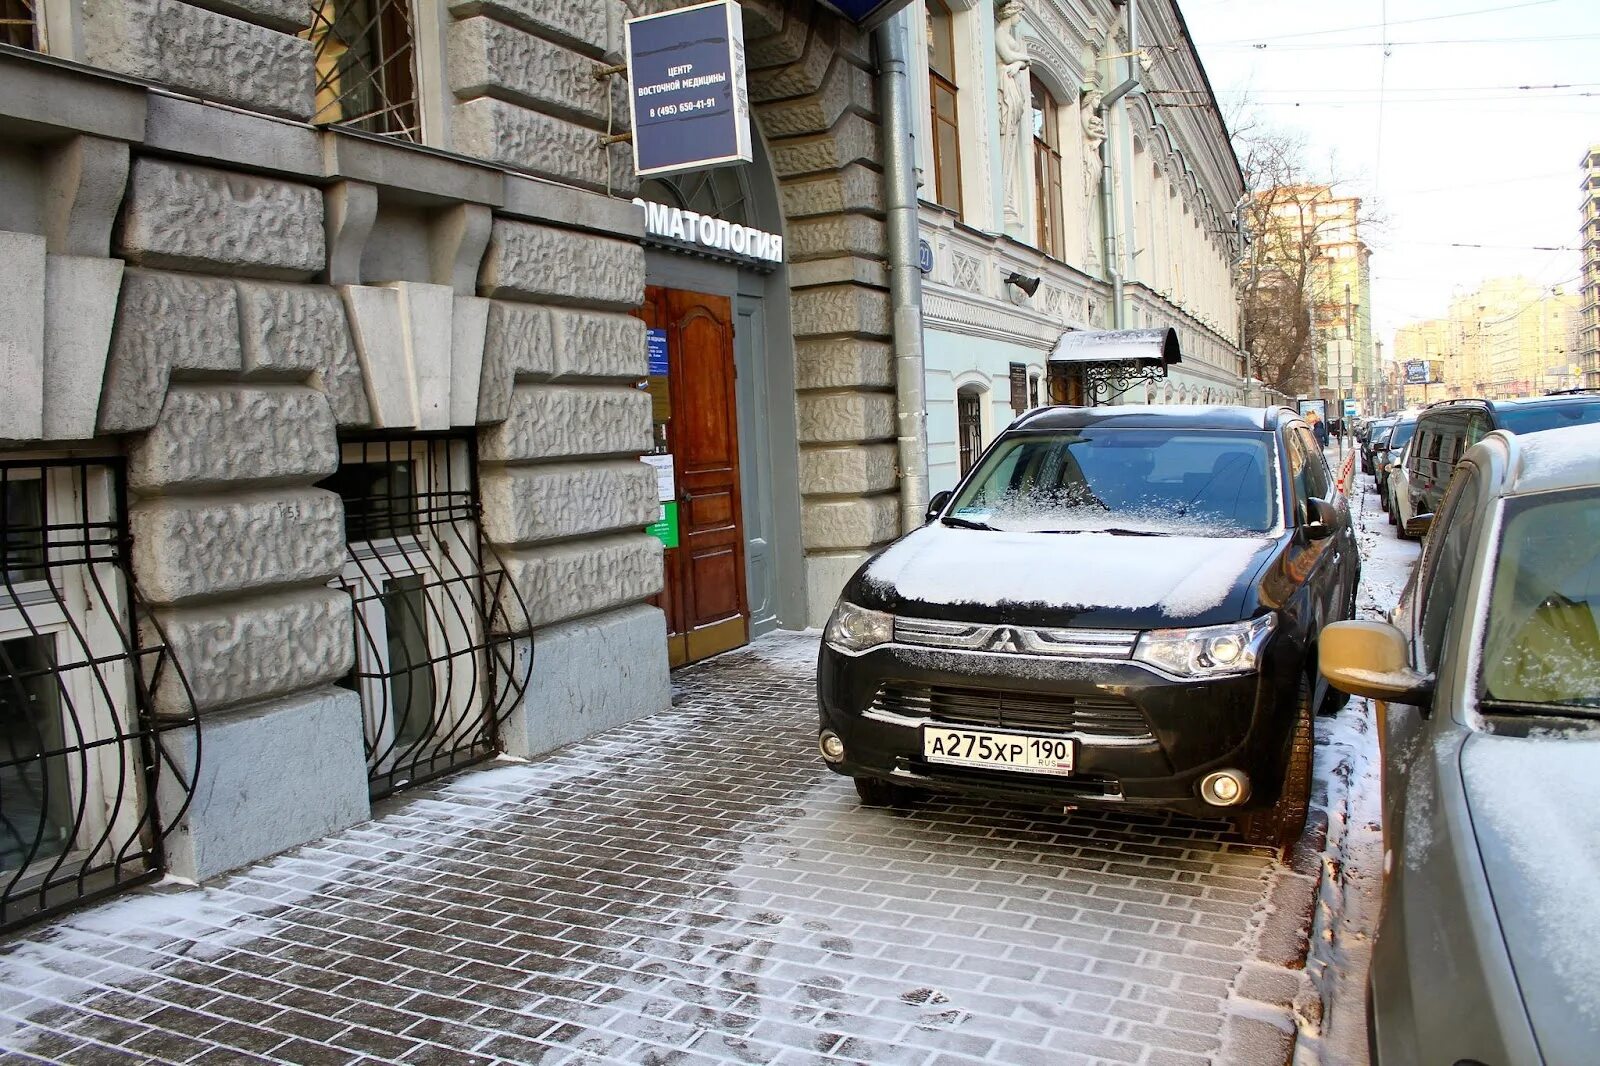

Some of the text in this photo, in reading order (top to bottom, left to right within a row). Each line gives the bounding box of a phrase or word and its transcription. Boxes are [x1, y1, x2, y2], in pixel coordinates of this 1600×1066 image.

[668, 64, 692, 77] ЦЕНТР
[638, 72, 726, 96] ВОСТОЧНОЙ МЕДИЦИНЫ
[649, 97, 715, 117] 8 (495) 650-41-91
[932, 733, 1066, 762] А275ХР 190
[1038, 758, 1057, 768] RUS
